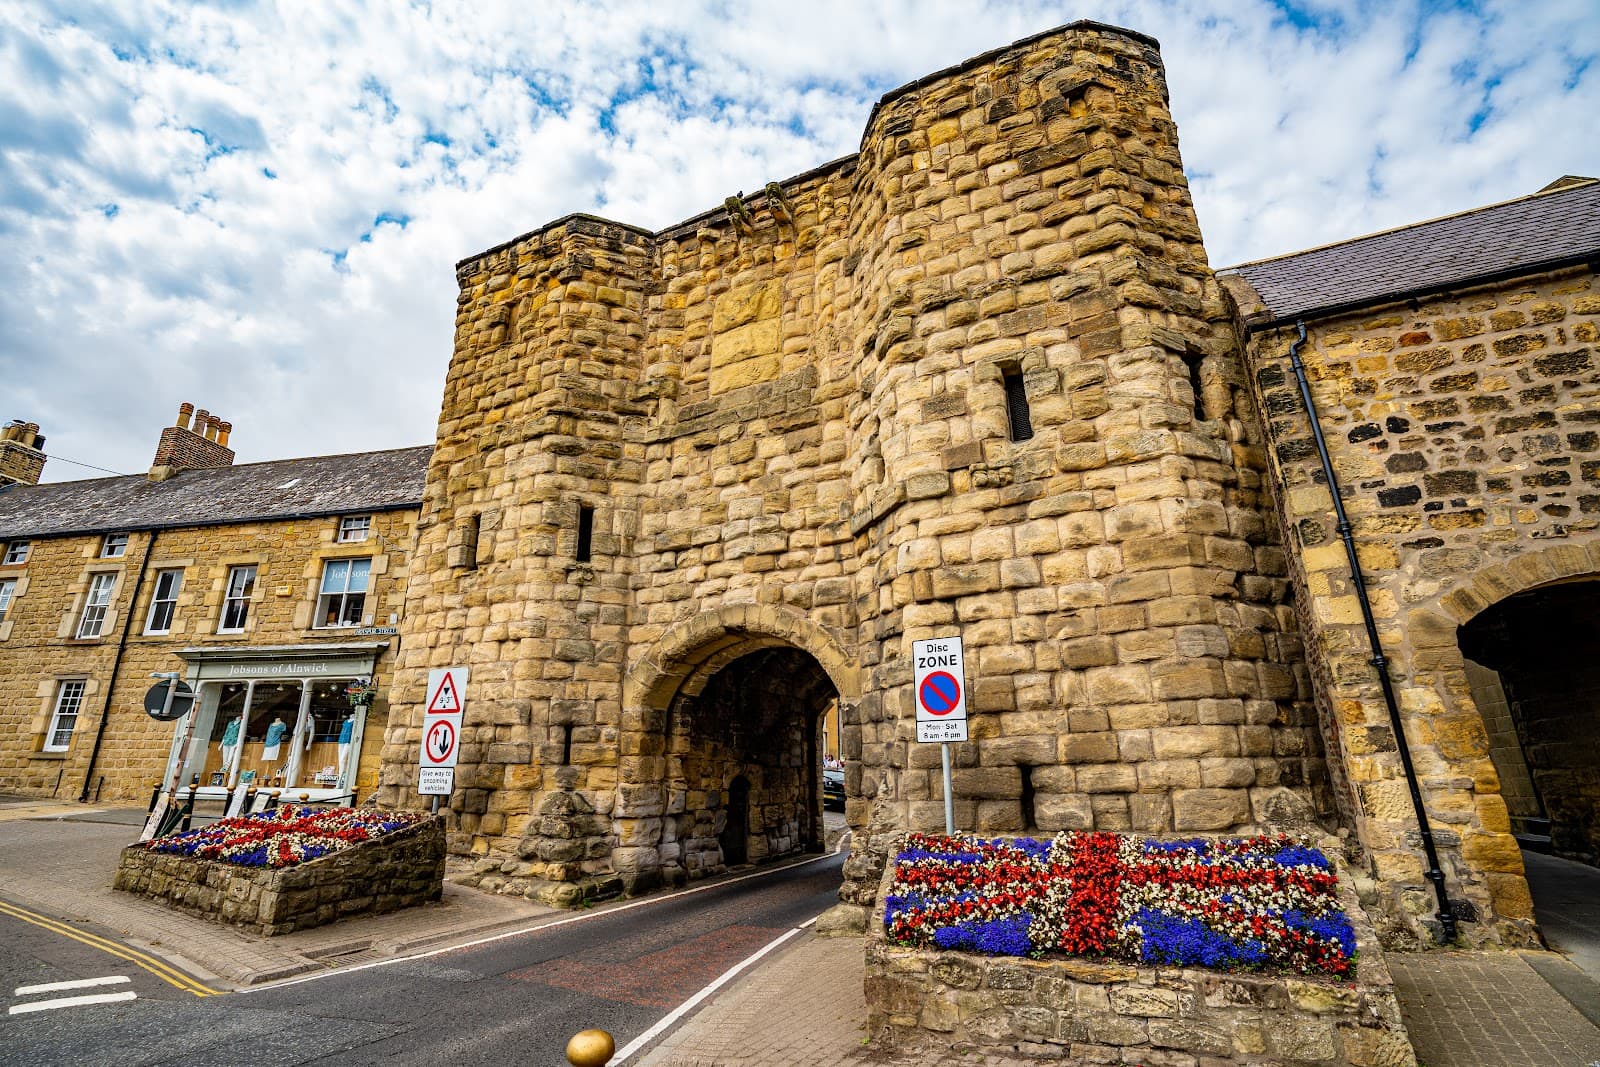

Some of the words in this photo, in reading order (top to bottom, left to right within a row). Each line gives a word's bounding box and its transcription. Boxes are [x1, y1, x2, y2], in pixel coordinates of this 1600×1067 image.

[926, 644, 949, 653] Disc
[918, 654, 958, 668] ZONE
[228, 664, 268, 676] Jobsons
[271, 663, 283, 673] of
[285, 662, 329, 673] Alnwick
